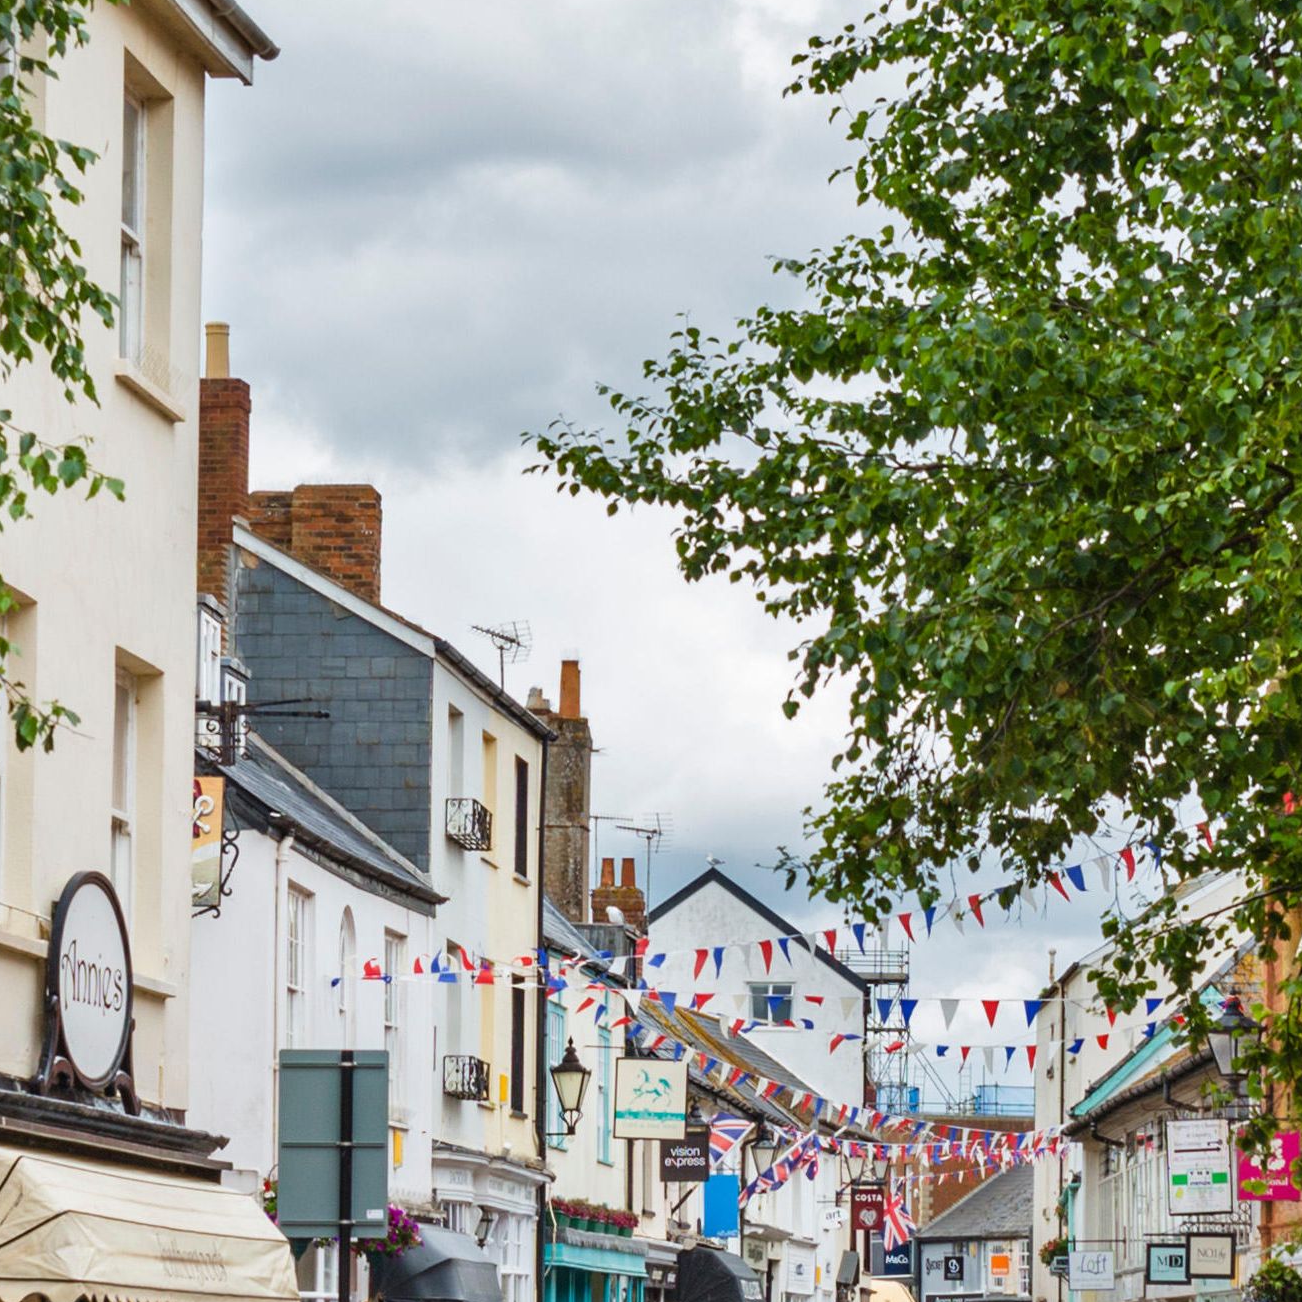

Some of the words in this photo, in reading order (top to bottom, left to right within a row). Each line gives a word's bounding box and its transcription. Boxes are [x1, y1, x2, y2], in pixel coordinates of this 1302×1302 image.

[61, 939, 124, 1016] Annies
[670, 1147, 700, 1156] vision
[664, 1157, 706, 1168] express
[854, 1193, 883, 1202] COSTA
